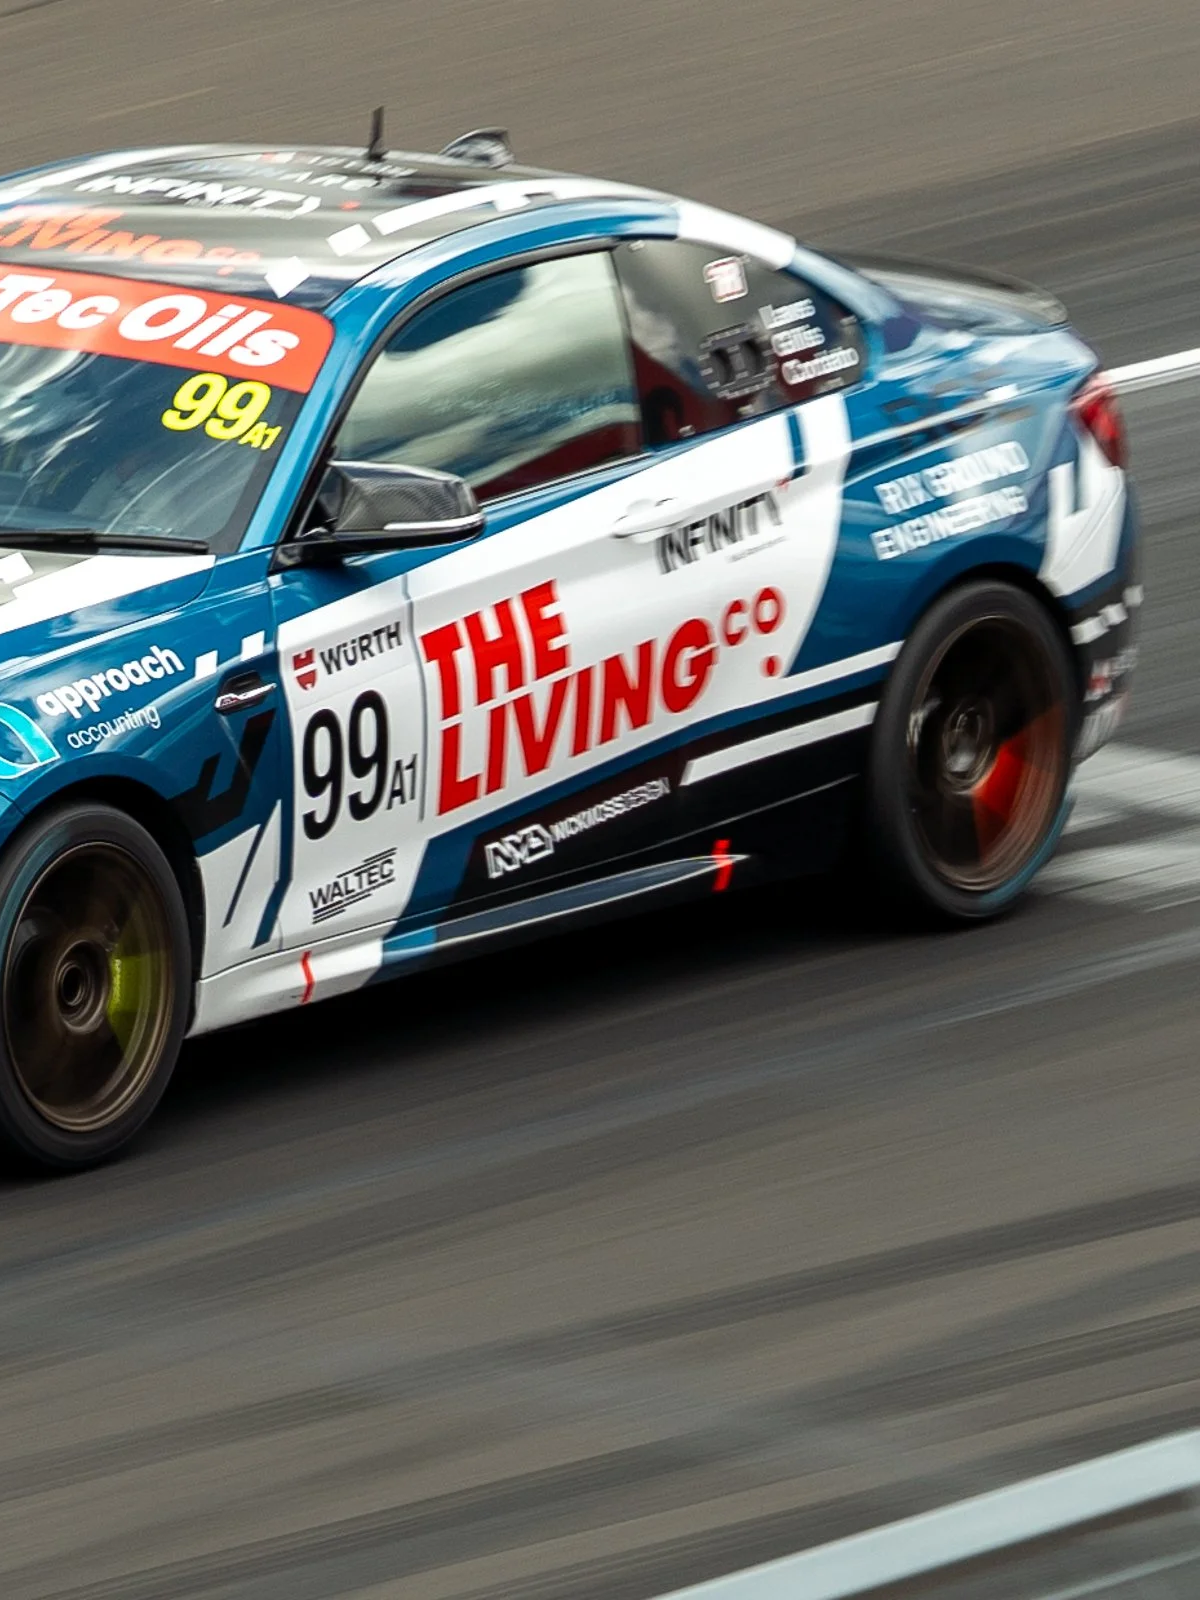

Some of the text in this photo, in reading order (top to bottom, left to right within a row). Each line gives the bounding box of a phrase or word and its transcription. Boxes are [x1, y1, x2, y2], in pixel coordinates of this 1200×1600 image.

[118, 294, 300, 367] Oils
[160, 372, 282, 450] 99 A1
[36, 645, 185, 719] approach
[319, 621, 402, 675] WÜRTH
[420, 578, 572, 720] THE
[67, 706, 161, 749] accounting
[437, 617, 721, 816] LIVING
[302, 689, 419, 841] 99 A1
[308, 859, 396, 909] WALTEC
